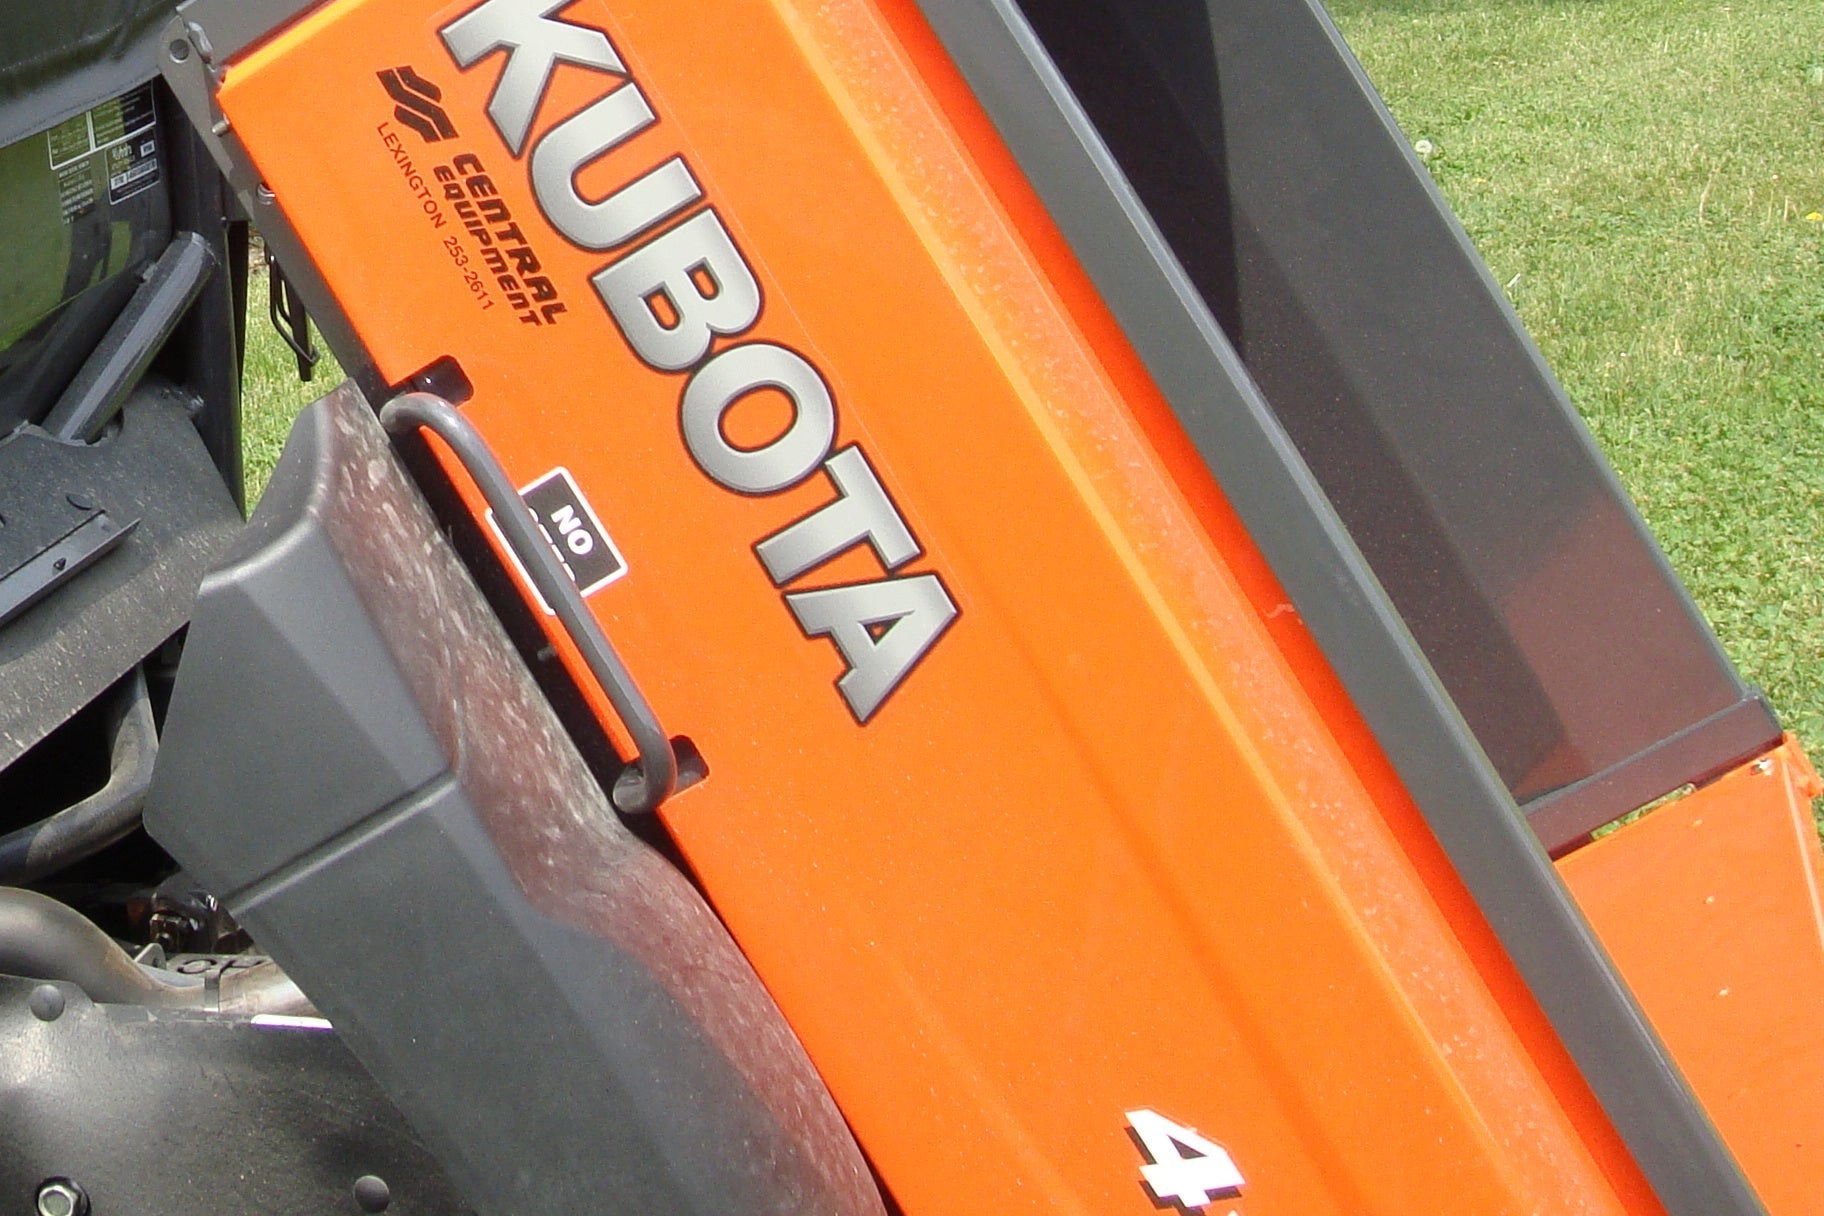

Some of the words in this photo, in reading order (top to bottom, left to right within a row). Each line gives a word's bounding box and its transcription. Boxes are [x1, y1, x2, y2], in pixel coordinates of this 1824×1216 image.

[377, 122, 447, 229] LEXINGTON
[443, 236, 495, 310] 253-2611
[433, 165, 543, 326] EQUIPMENT
[453, 153, 567, 325] CENTRAL
[551, 505, 593, 555] NO
[1124, 1109, 1245, 1216] 4
